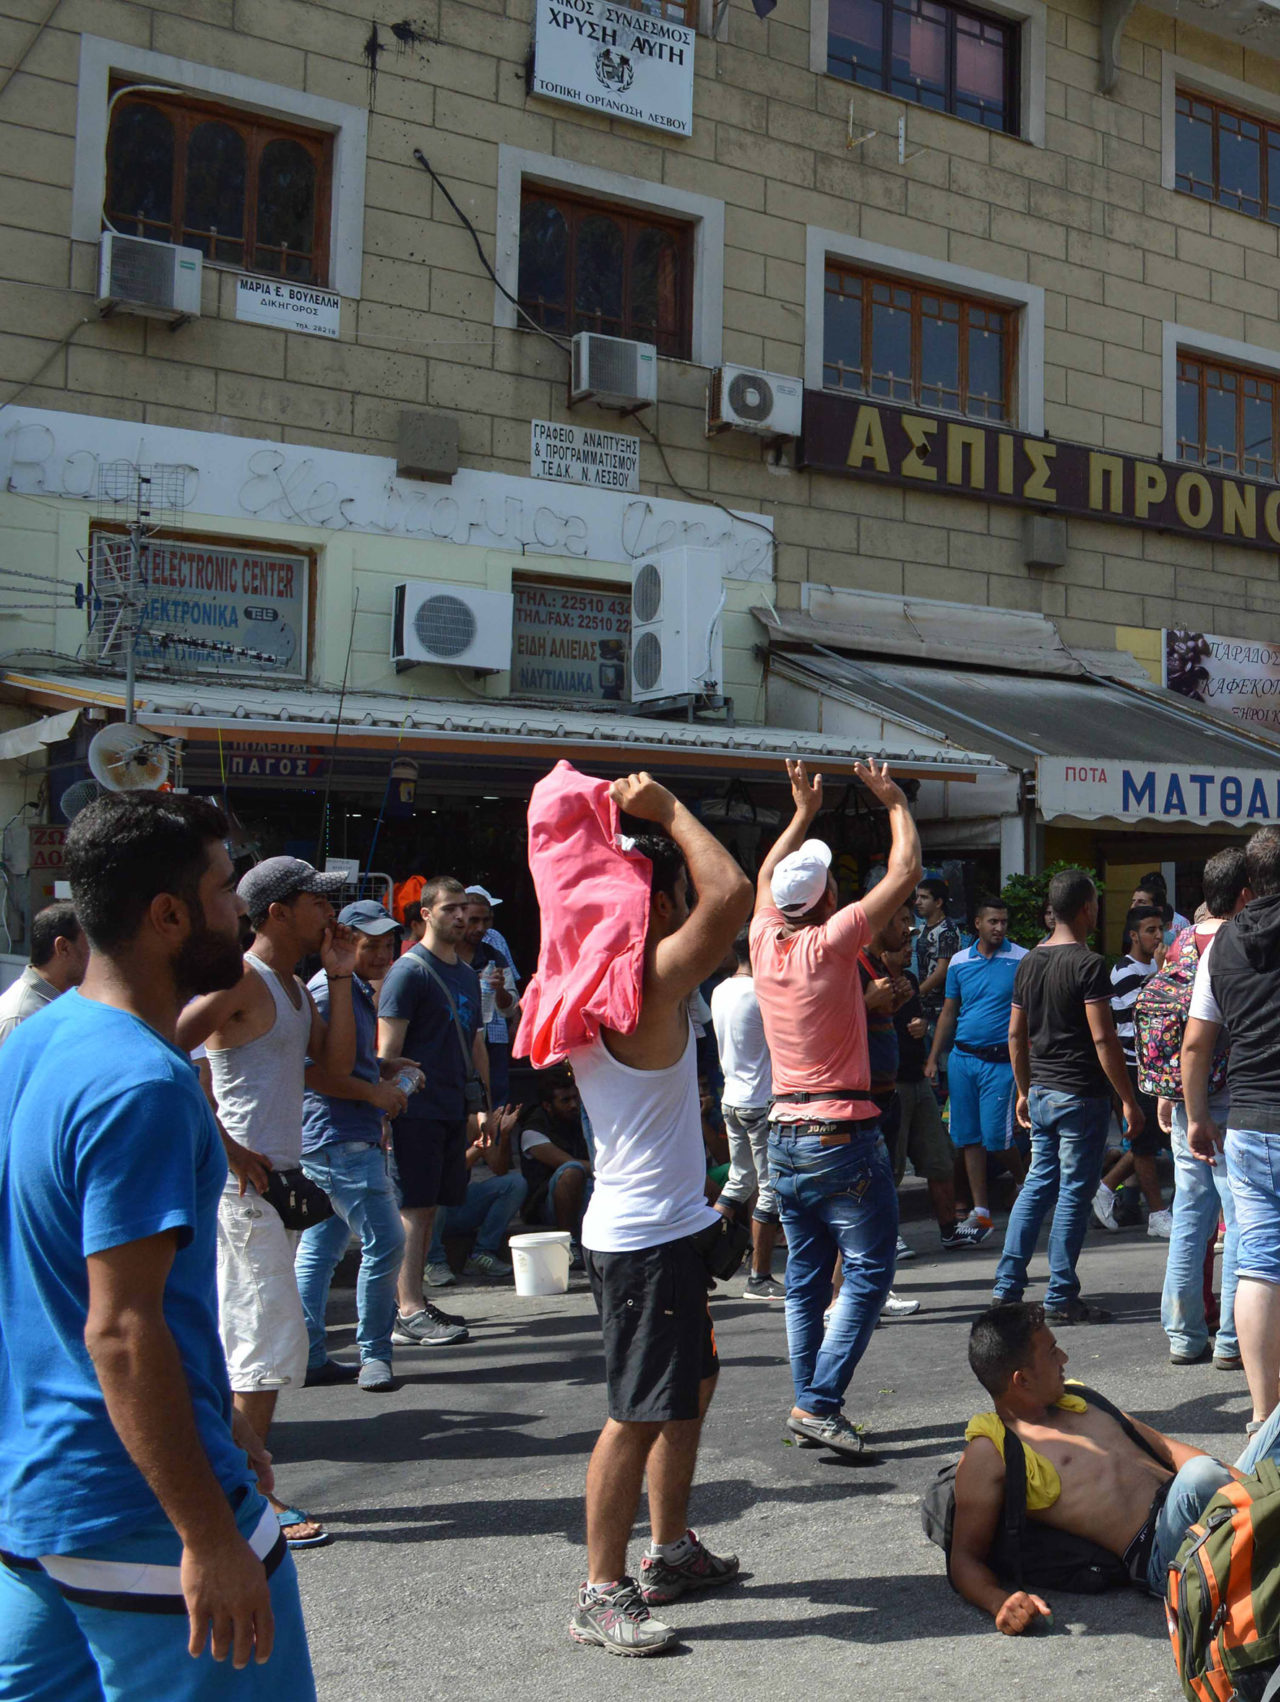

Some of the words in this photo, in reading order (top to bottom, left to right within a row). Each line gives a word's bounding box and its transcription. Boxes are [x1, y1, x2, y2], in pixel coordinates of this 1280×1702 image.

[549, 7, 617, 46] ΧΡΥΣΗ
[631, 35, 684, 66] ΑΥΓΗ
[606, 8, 690, 45] ΣΥΝΔΕΣΜΟΣ
[539, 79, 582, 100] ΤΟΠΙΚΗ
[585, 94, 643, 118] ΟΡΓΑΝΩΣΗ
[648, 113, 688, 131] ΛΕΣΒΟΥ
[240, 279, 271, 296] ΜΑΡΙΑ
[275, 286, 284, 297] Ε.
[289, 289, 339, 309] ΒΟΥΛΕΛΛΗ
[260, 298, 319, 316] ΔΙΚΗΓΟΡΟΣ
[533, 424, 574, 444] ΓΡΑΦΕΙΟ
[583, 432, 637, 455] ΑΝΑΠΤΥΞΗΣ
[847, 404, 1058, 503] ΑΣΠΙΣ
[534, 442, 541, 457] &
[546, 444, 637, 472] ΠΡΟΓΡΑΜΜΑΤΙΣΜΟΥ
[541, 460, 574, 479] Τ.Ε.Δ.Κ.
[581, 467, 591, 482] Ν.
[595, 469, 629, 487] ΛΕΣΒΟΥ
[152, 550, 238, 593] ELECTRONIC
[242, 558, 294, 598] CENTER
[516, 591, 556, 607] ΤΗΛ.:
[561, 595, 604, 613] 22510
[608, 602, 631, 615] 434
[516, 608, 574, 626] ΤΗΛ./FAX:
[578, 615, 612, 631] 22510
[616, 619, 632, 633] 22
[518, 635, 546, 657] ΕΙΔΗ
[550, 638, 598, 661] ΑΛΙΕΙΑΣ
[520, 667, 594, 693] ΝΑΥΤΙΛΙΑΚΑ
[232, 756, 307, 776] ΠΑΓΟΣ
[1065, 766, 1107, 784] ΠΟΤΑ
